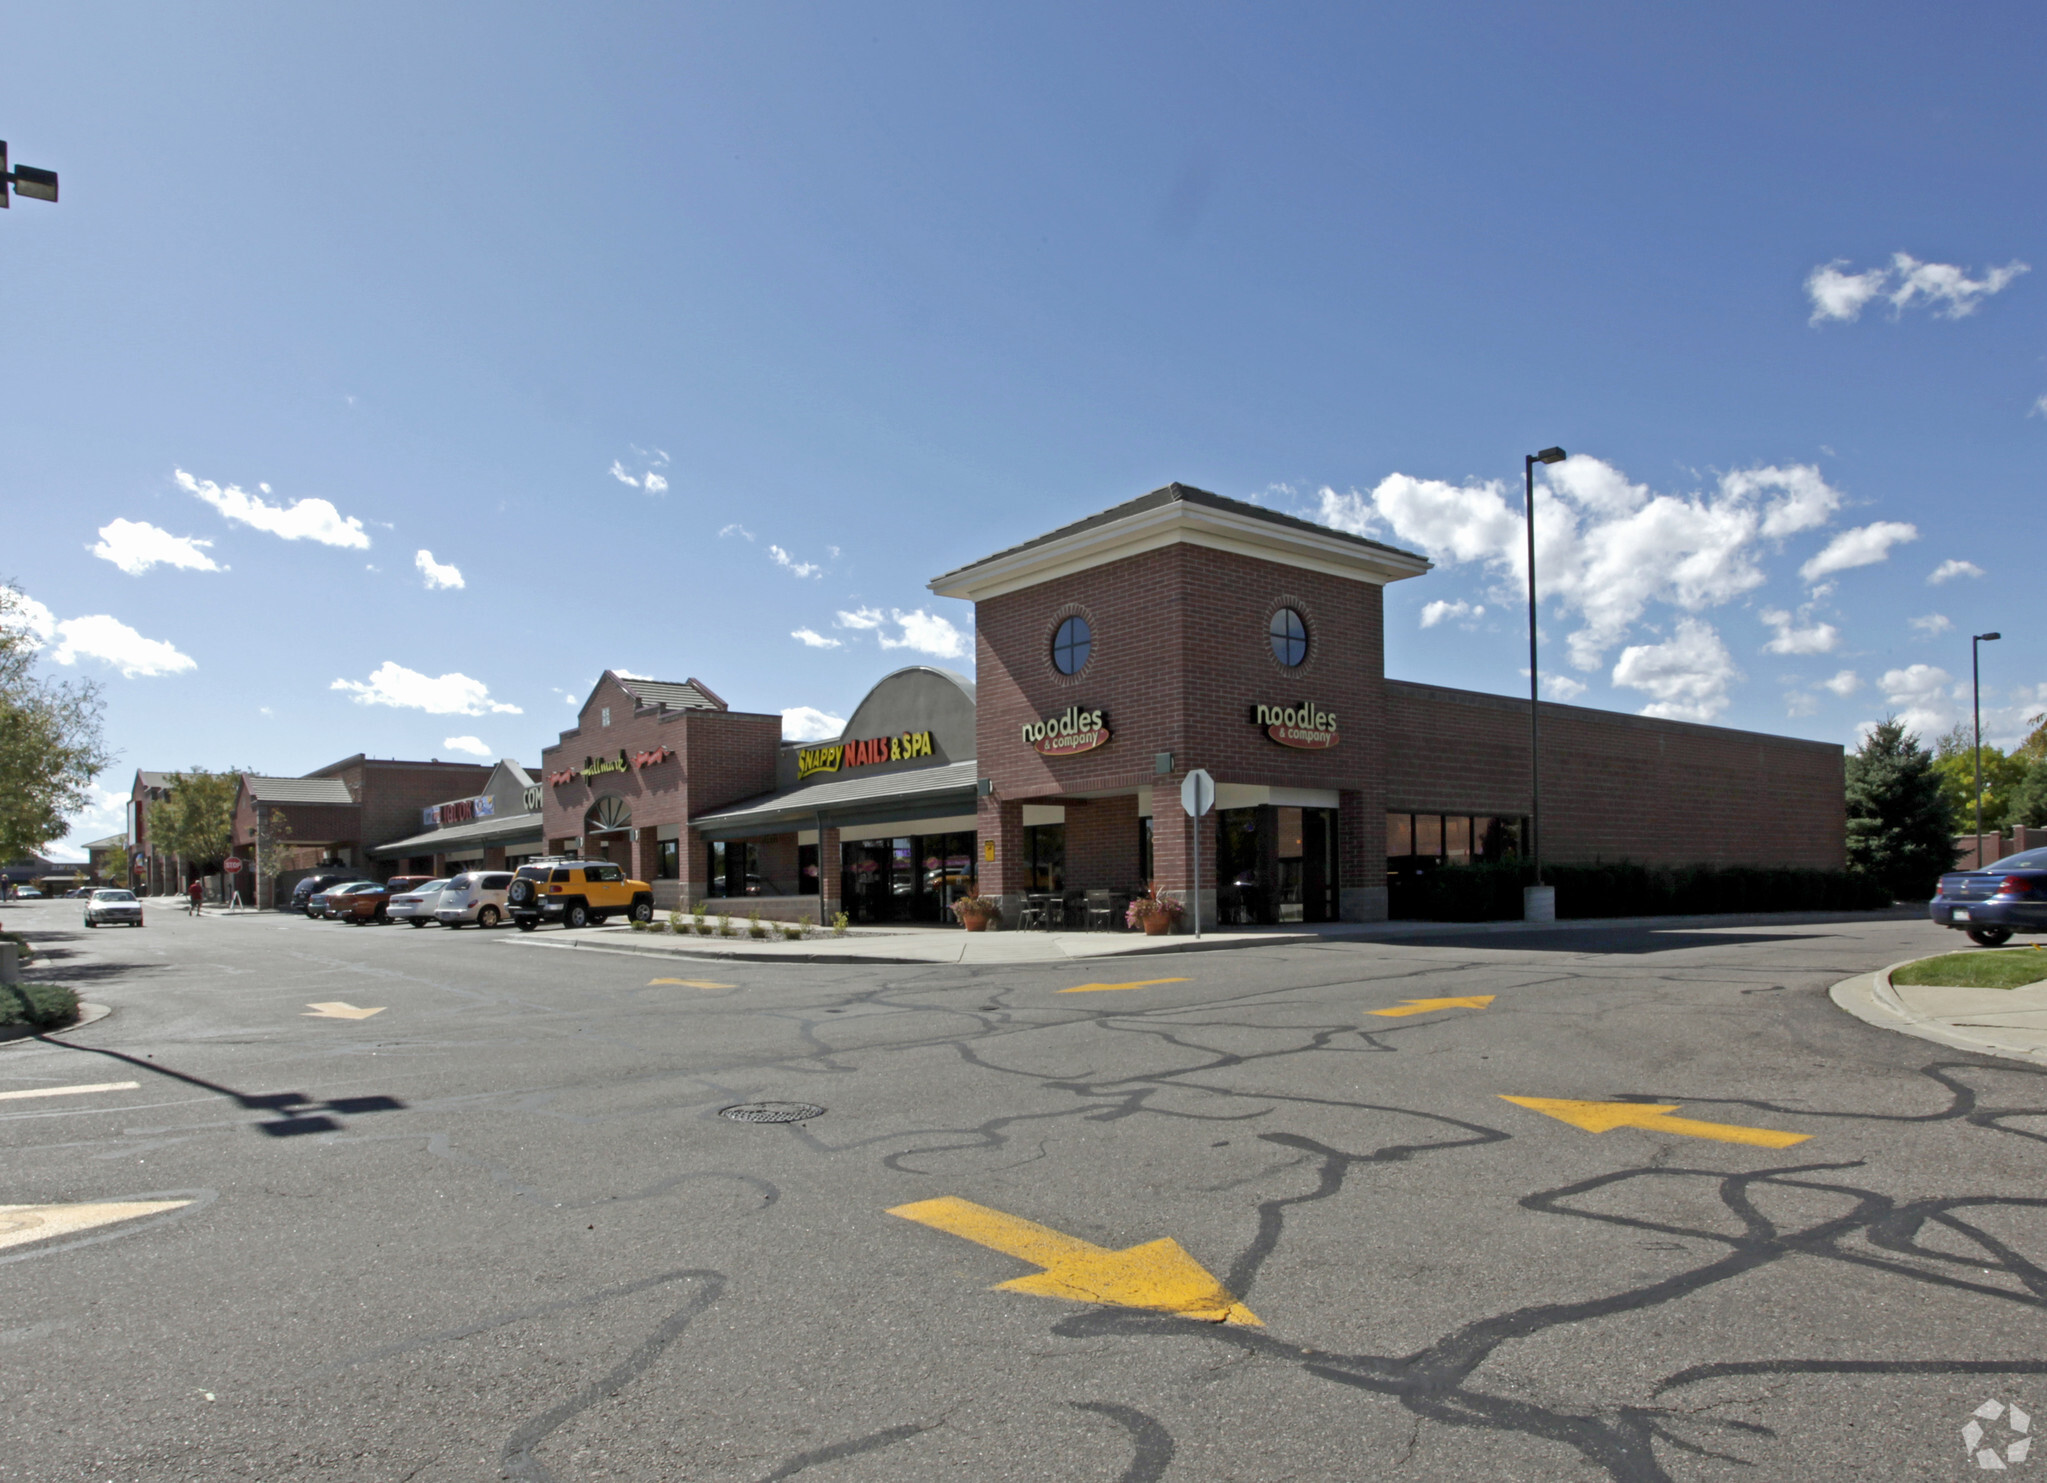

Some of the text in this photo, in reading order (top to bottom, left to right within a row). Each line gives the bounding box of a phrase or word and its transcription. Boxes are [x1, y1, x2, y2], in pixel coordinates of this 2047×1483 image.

[1022, 706, 1103, 742] noodles
[1257, 702, 1337, 732] noodles
[1044, 731, 1099, 750] & company
[1279, 727, 1331, 748] & company
[798, 731, 932, 780] SNAPPY NAILS & SPA
[442, 799, 473, 824] IQUOR
[225, 861, 241, 869] STOP
